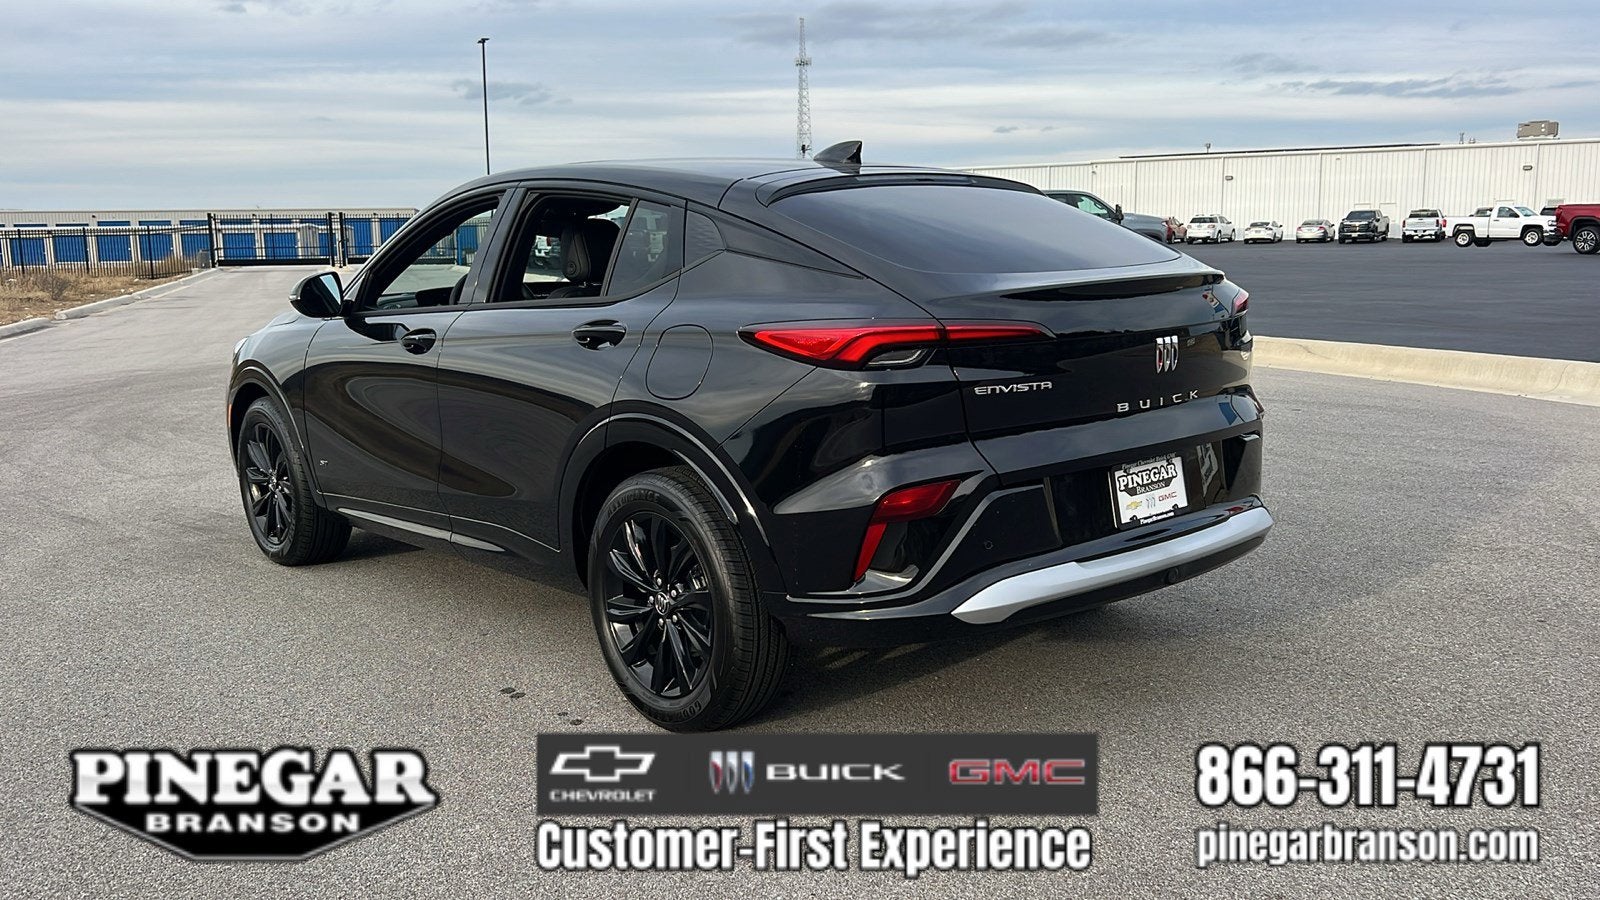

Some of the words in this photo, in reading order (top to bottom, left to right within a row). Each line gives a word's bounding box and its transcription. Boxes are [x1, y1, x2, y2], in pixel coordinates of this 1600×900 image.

[974, 381, 1053, 395] ENVISTA
[1116, 389, 1199, 413] BUICK
[1118, 464, 1177, 491] PINEGAR
[1158, 491, 1178, 502] GMC
